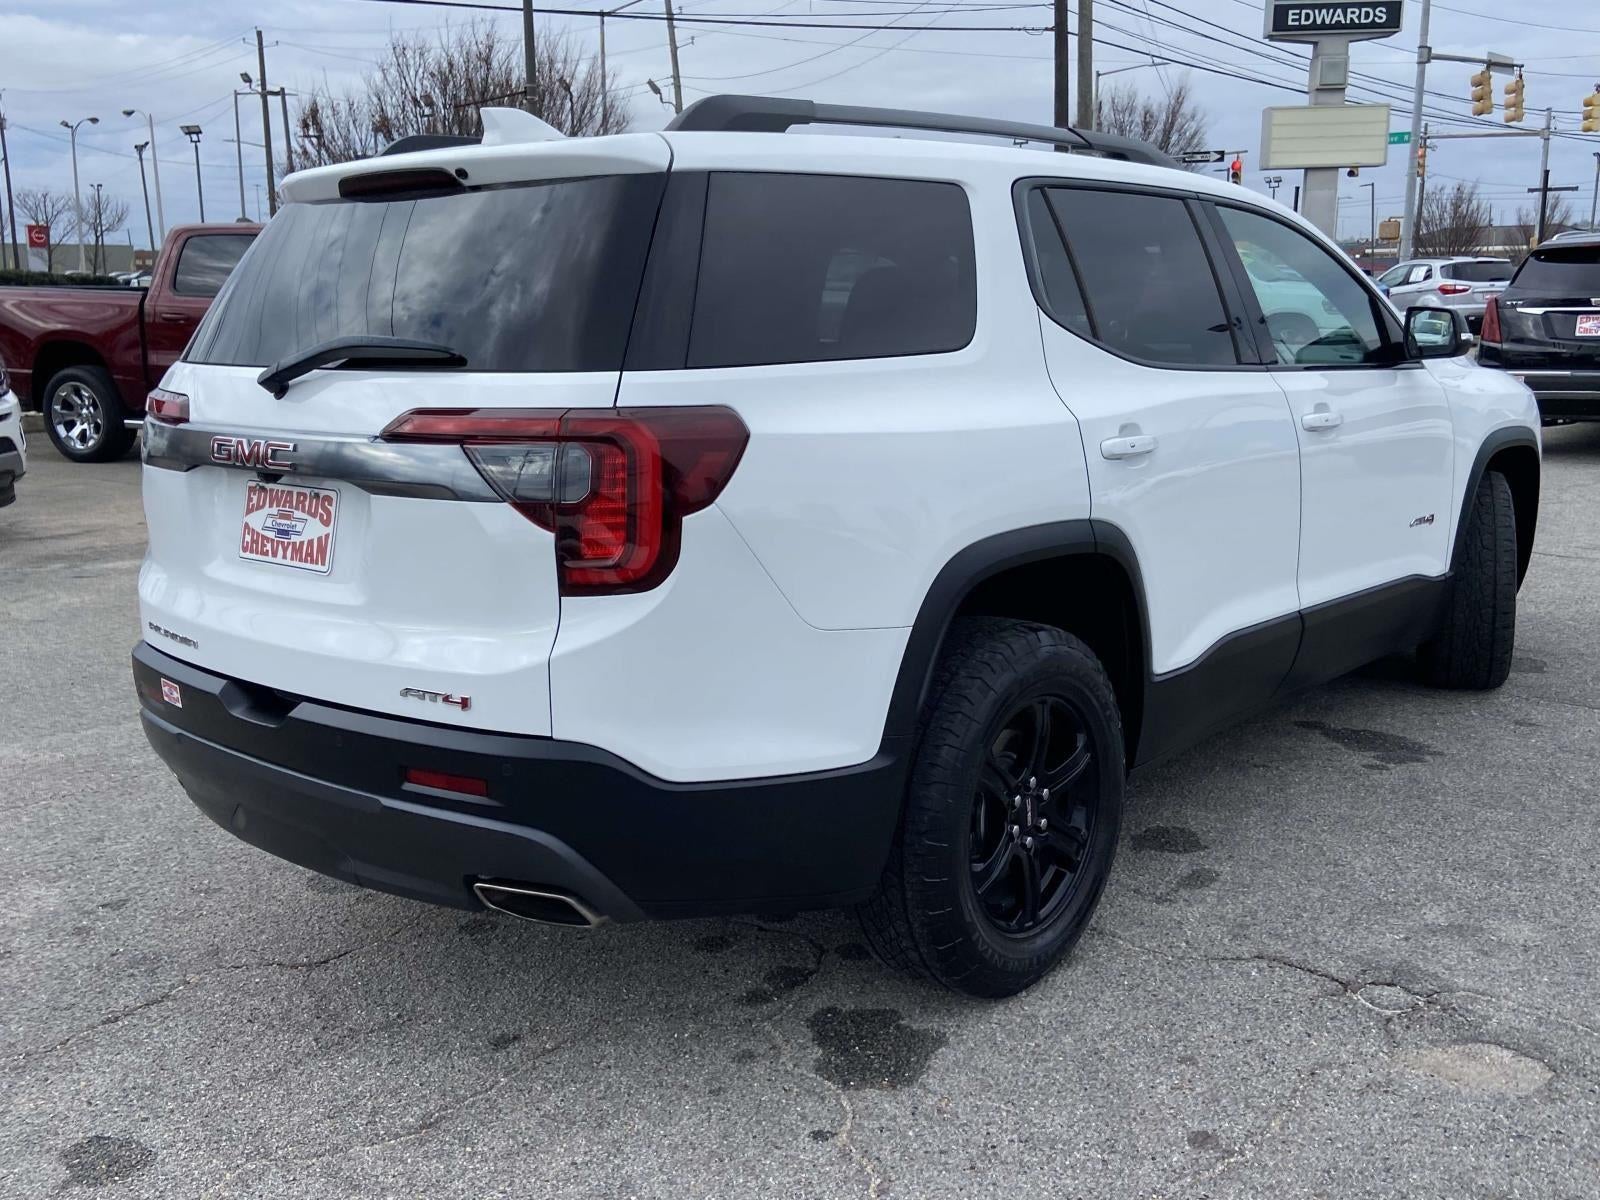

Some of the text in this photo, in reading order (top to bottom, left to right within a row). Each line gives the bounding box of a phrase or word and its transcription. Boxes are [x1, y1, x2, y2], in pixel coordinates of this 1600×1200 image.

[1287, 7, 1387, 25] EDWARDS
[210, 435, 297, 471] GMC
[245, 485, 334, 528] EDWARDS
[271, 519, 297, 531] Chevrolet
[241, 521, 331, 567] CHEVYMAN
[400, 686, 472, 711] AT4
